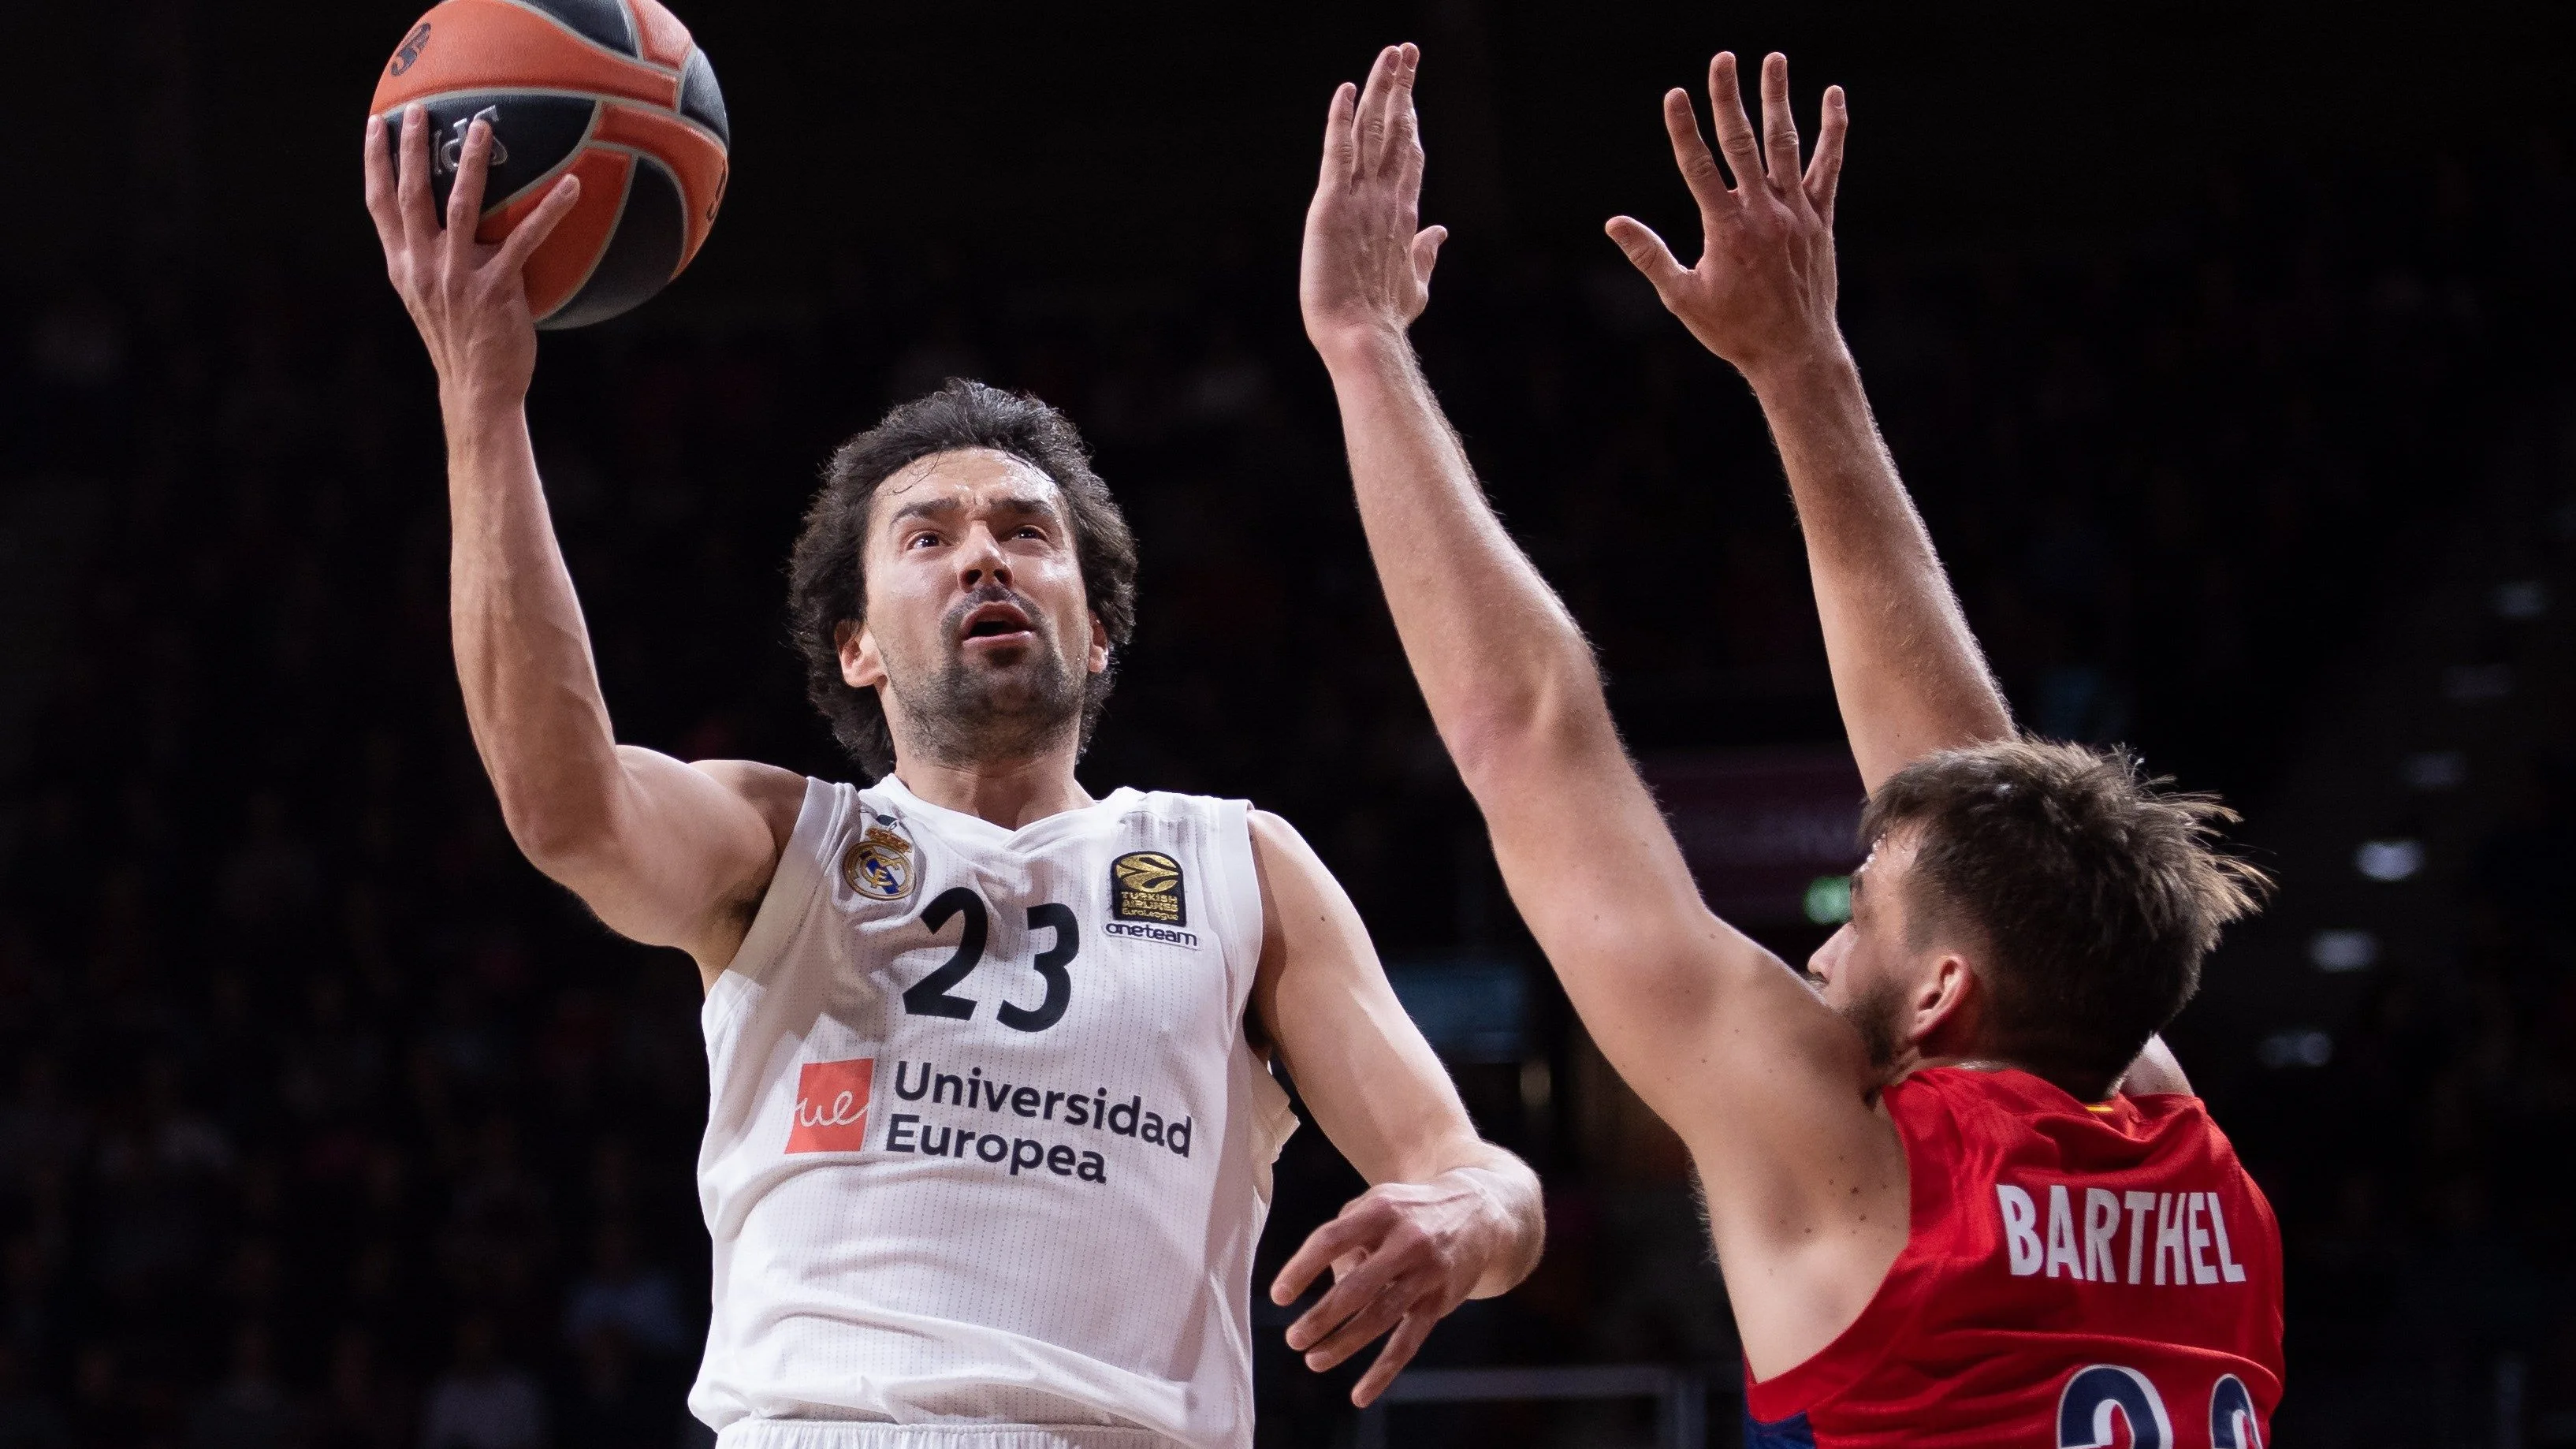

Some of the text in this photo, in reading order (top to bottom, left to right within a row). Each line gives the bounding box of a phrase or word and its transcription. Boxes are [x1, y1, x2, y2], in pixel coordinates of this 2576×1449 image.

[1121, 892, 1178, 904] TURKISH
[1122, 900, 1179, 913] AIRLINES
[903, 886, 1080, 1033] 23
[1105, 923, 1197, 947] oneteam
[894, 1059, 1192, 1158] Universidad
[885, 1112, 1107, 1184] Europea
[1996, 1183, 2247, 1286] BARTHEL
